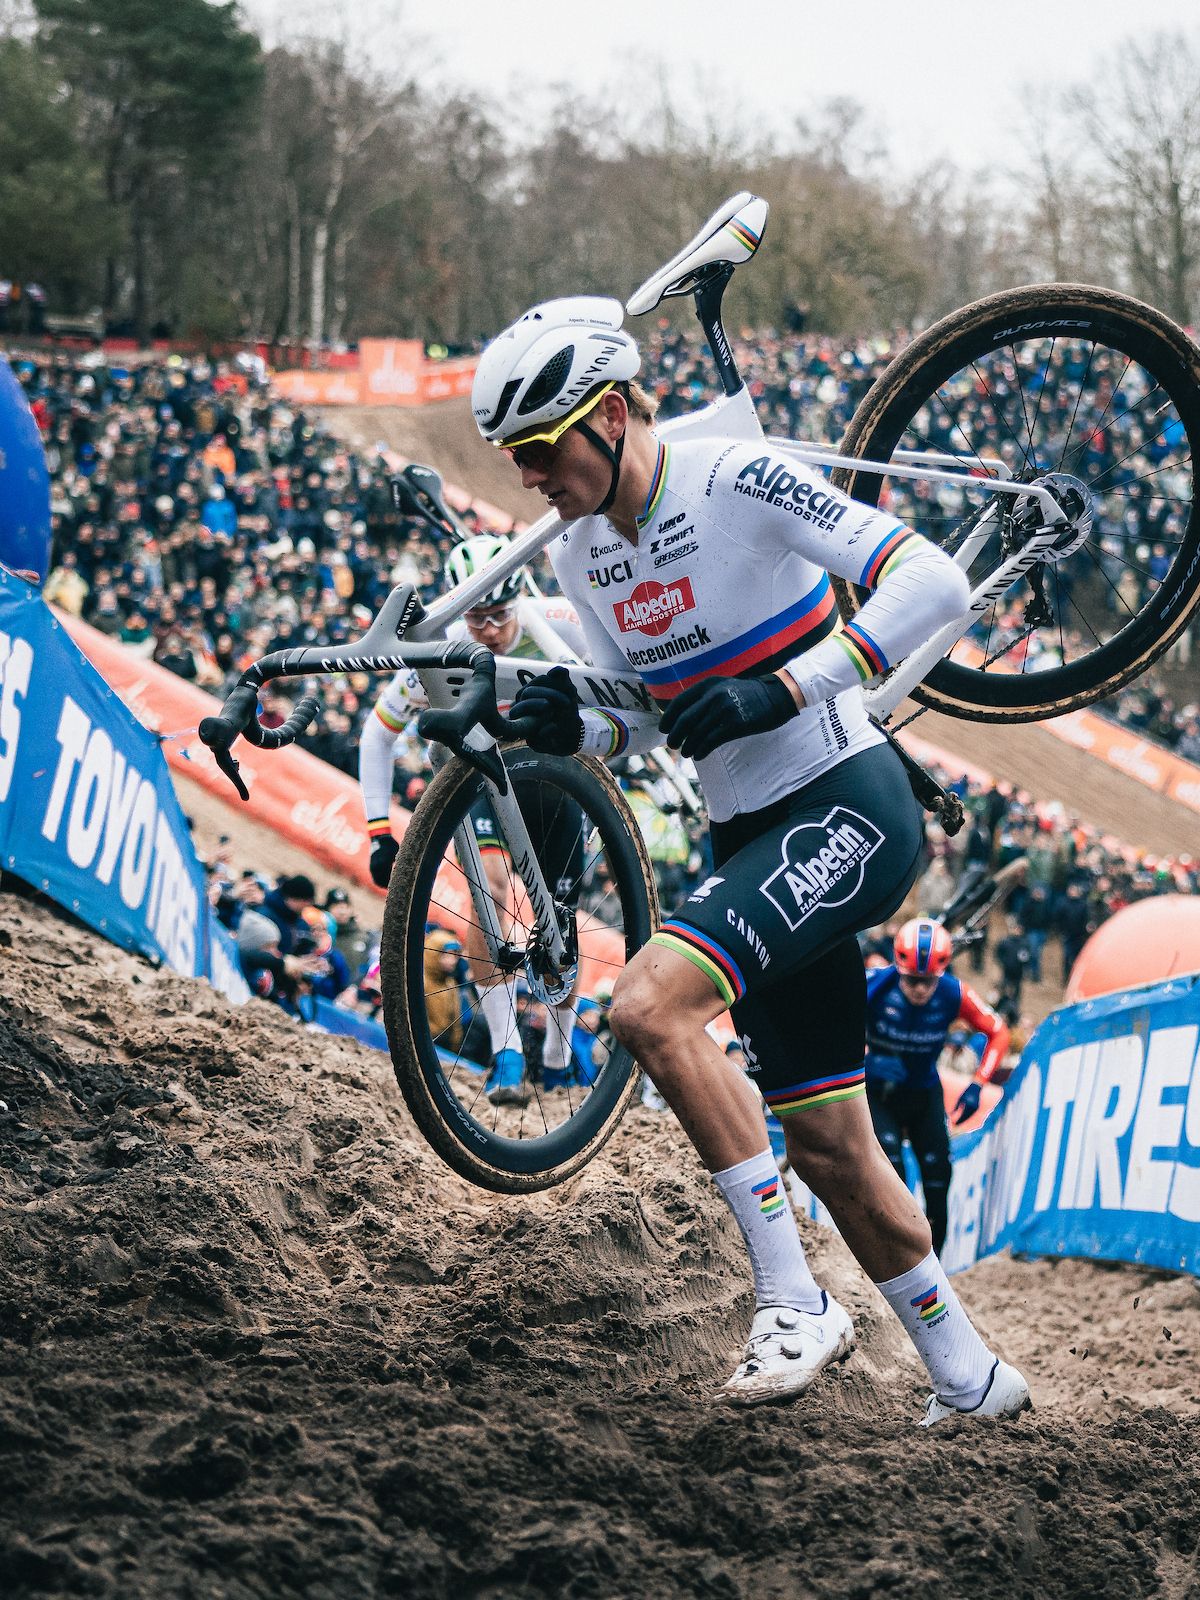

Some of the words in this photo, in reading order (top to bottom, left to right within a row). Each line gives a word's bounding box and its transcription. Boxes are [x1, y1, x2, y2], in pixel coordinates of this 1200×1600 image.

[712, 320, 732, 367] CANYON
[993, 319, 1093, 340] DURA-ACE
[556, 346, 618, 406] CANYON
[734, 481, 767, 501] HAIR
[773, 496, 836, 534] BOOSTER
[737, 456, 848, 524] Alpecin
[663, 525, 695, 547] ZWIFT
[595, 560, 633, 587] UCI
[970, 543, 1053, 611] CANYON
[397, 594, 418, 635] CANYON
[623, 587, 684, 624] Alpecin
[625, 620, 643, 631] HAIR
[647, 604, 686, 624] BOOSTER
[321, 655, 409, 673] CANYON
[626, 624, 712, 666] deceuninck
[819, 716, 832, 748] WINDOWS
[41, 695, 157, 911] TOYO
[784, 823, 866, 907] Alpecin
[799, 889, 826, 914] HAIR
[827, 840, 872, 889] BOOSTER
[726, 908, 771, 970] CANYON
[765, 1207, 788, 1223] ZWIFT
[926, 1310, 951, 1329] ZWIFT
